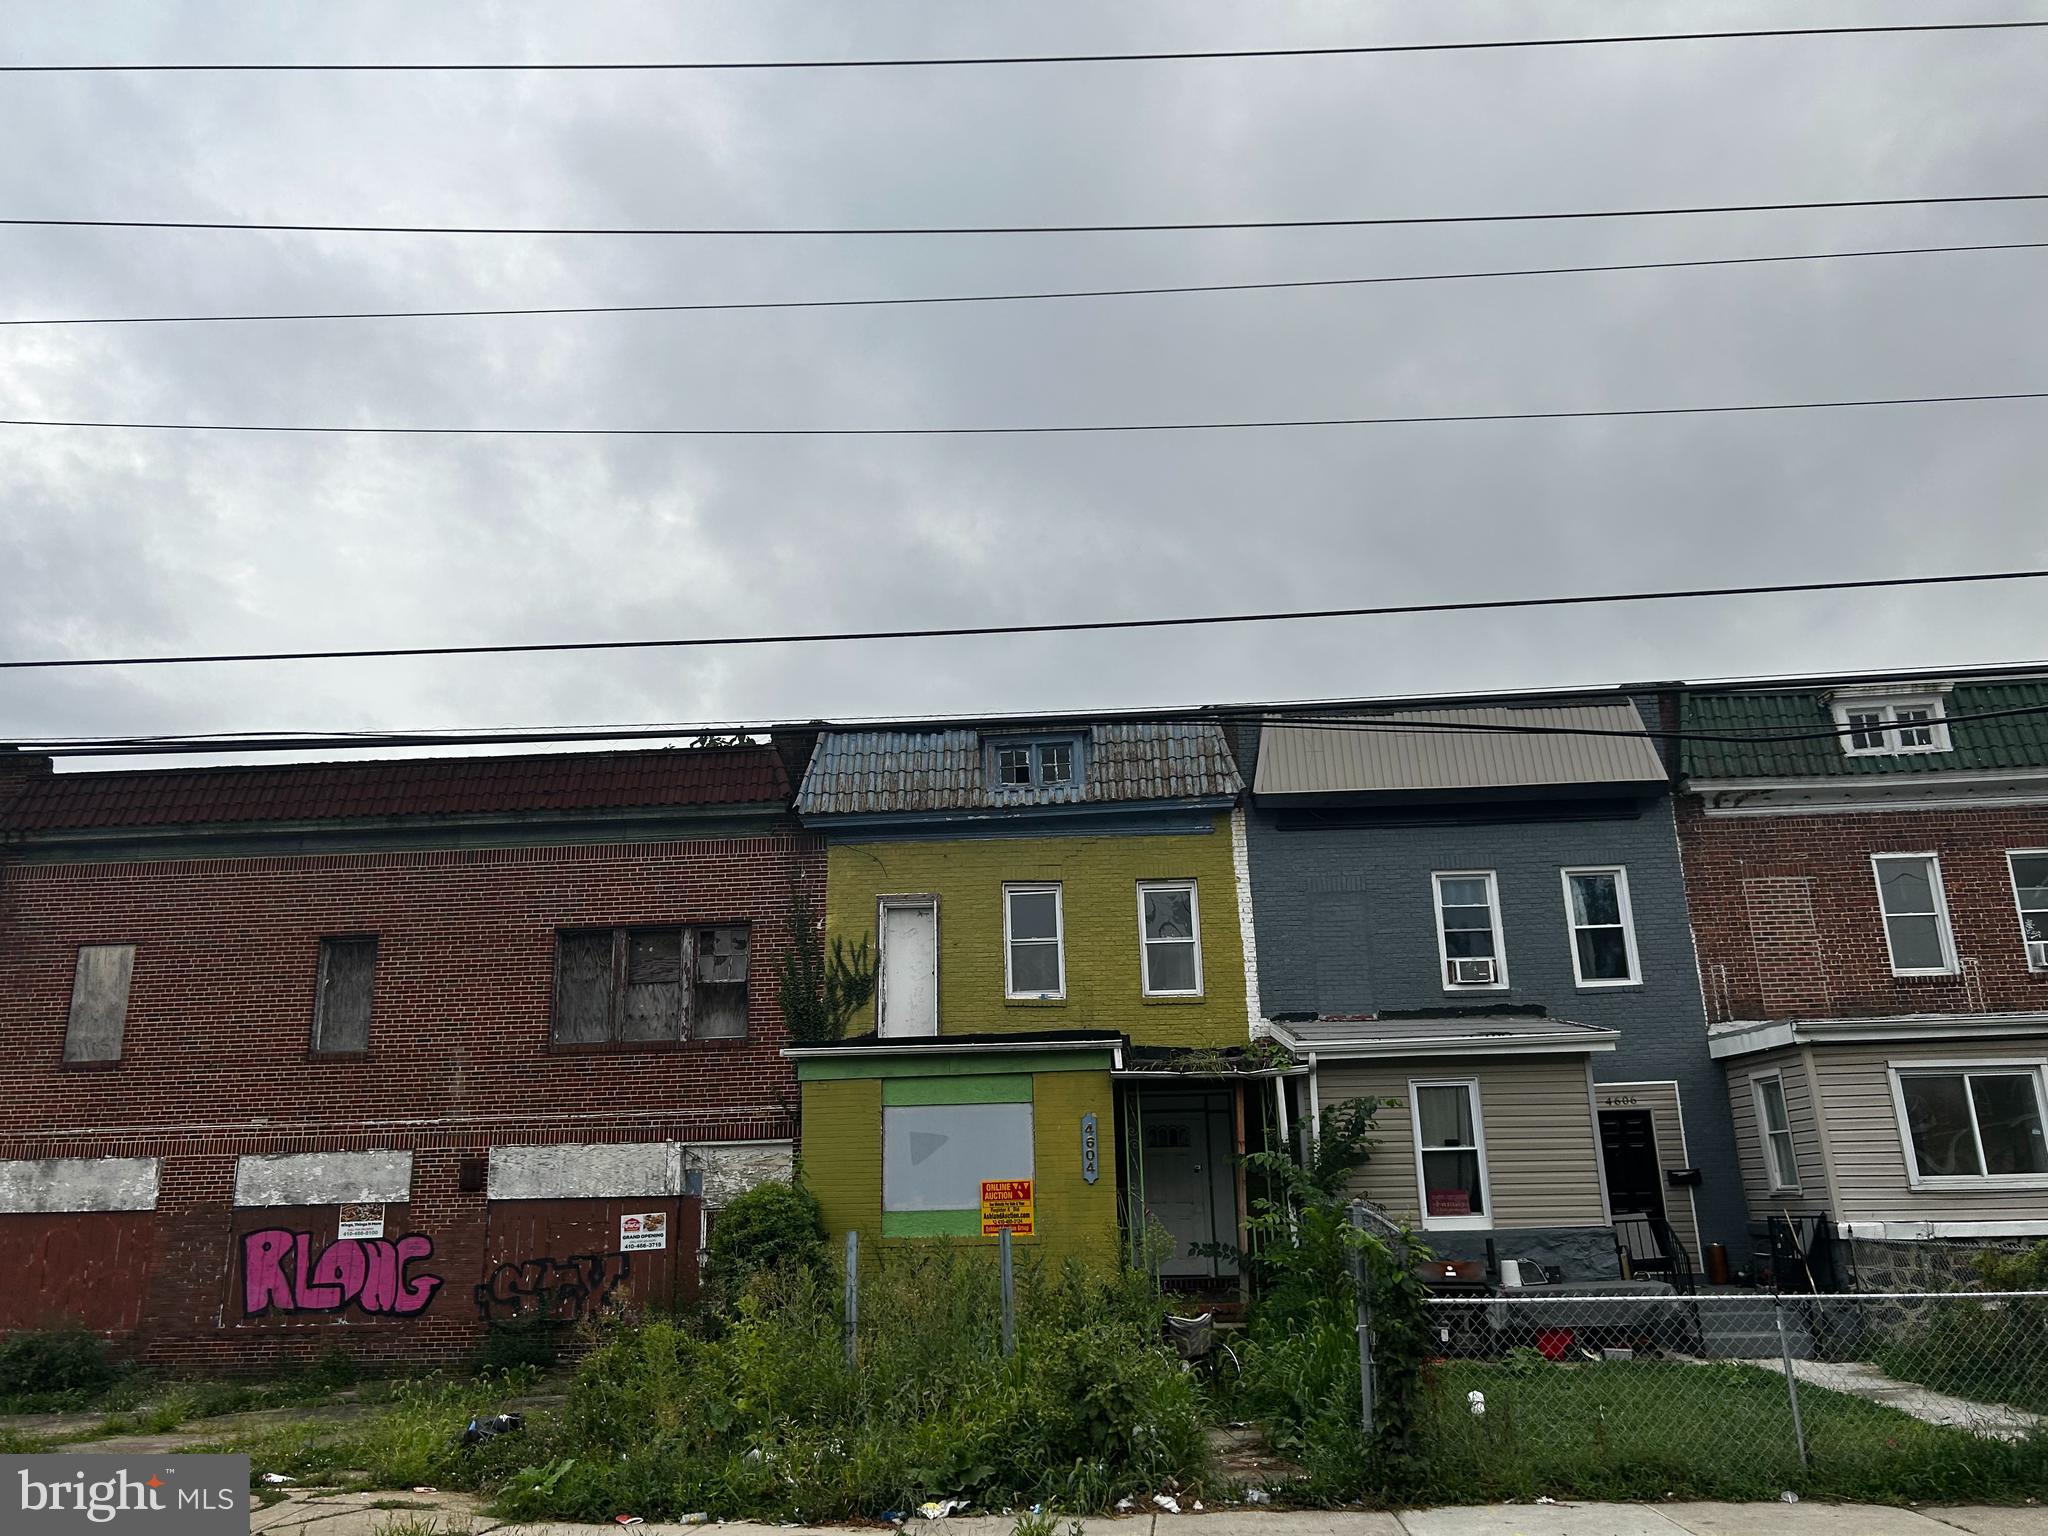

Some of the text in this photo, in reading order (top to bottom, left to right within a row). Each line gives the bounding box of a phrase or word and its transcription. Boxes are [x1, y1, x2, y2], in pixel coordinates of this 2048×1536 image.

[1605, 1096, 1637, 1106] 4606
[1084, 1122, 1096, 1174] 4604
[986, 1183, 1011, 1191] ONLINE
[985, 1191, 1013, 1200] AUCTION
